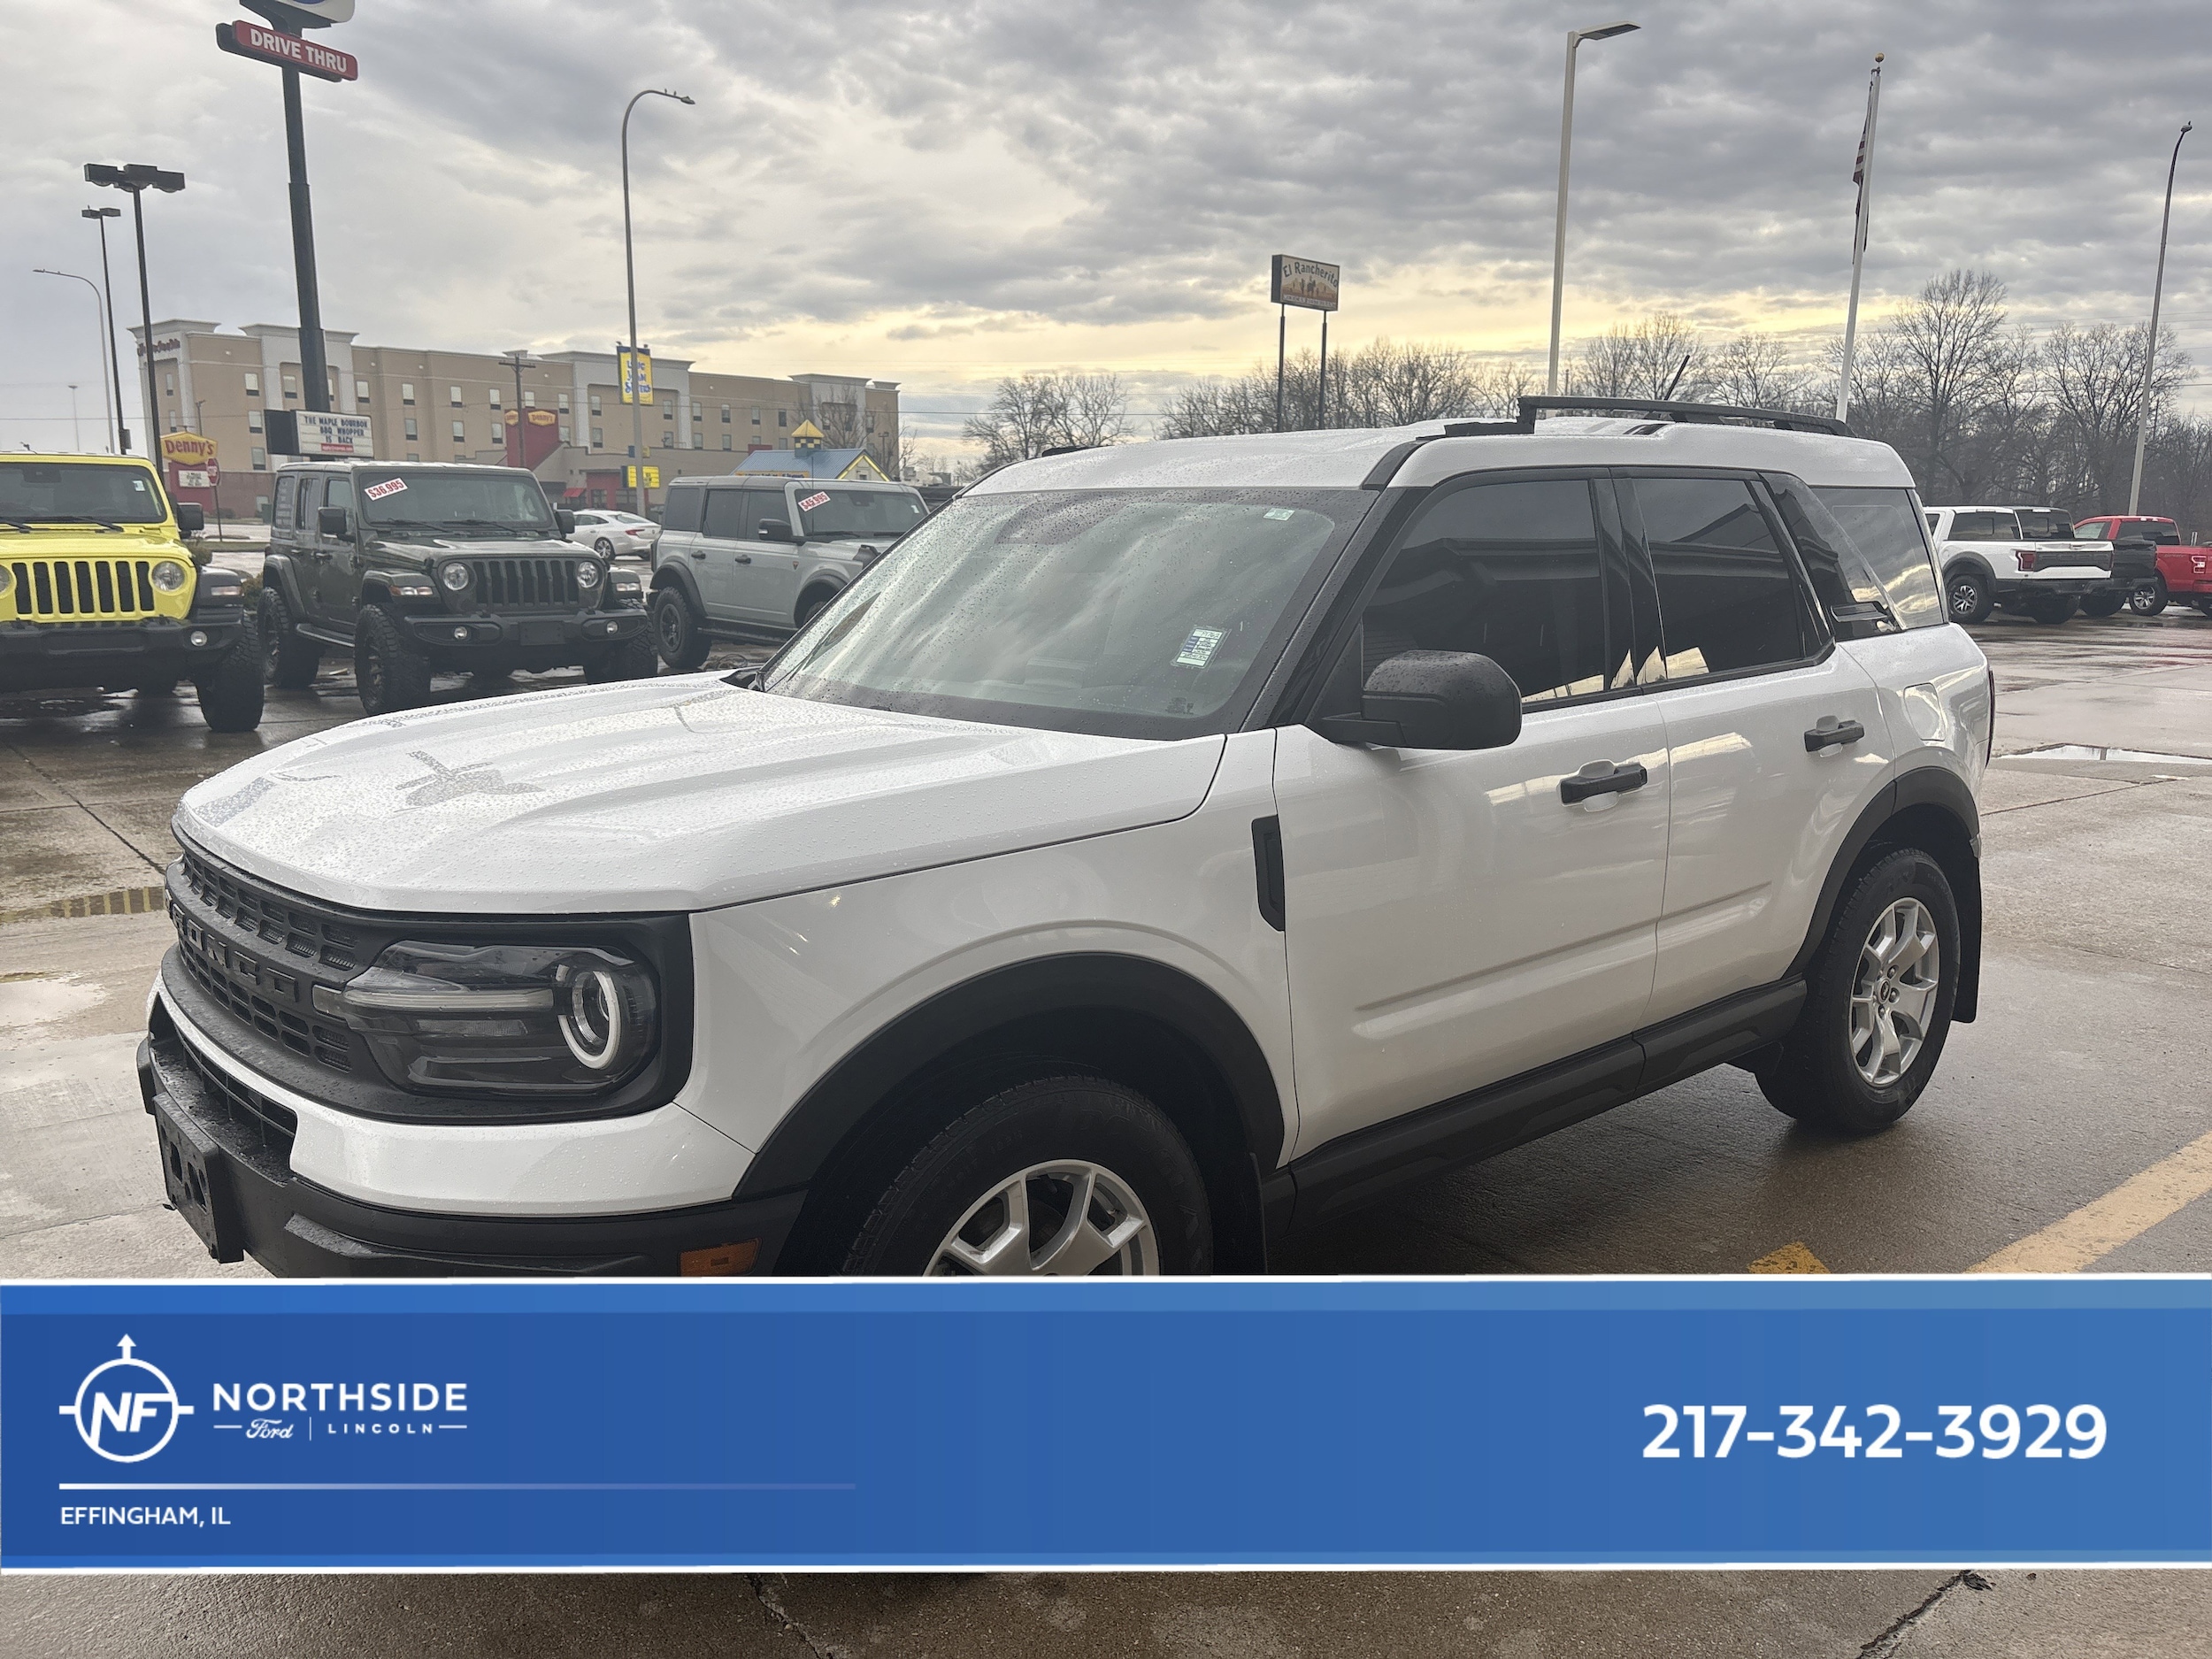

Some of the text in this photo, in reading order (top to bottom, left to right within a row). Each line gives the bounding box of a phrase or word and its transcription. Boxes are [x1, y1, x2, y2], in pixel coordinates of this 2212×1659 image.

[250, 28, 347, 73] DRIVE THRU
[1283, 262, 1338, 288] El Rancherito
[304, 416, 367, 428] THE MAPLE BOURBON
[165, 440, 214, 456] Denny's
[367, 480, 404, 498] $36,995
